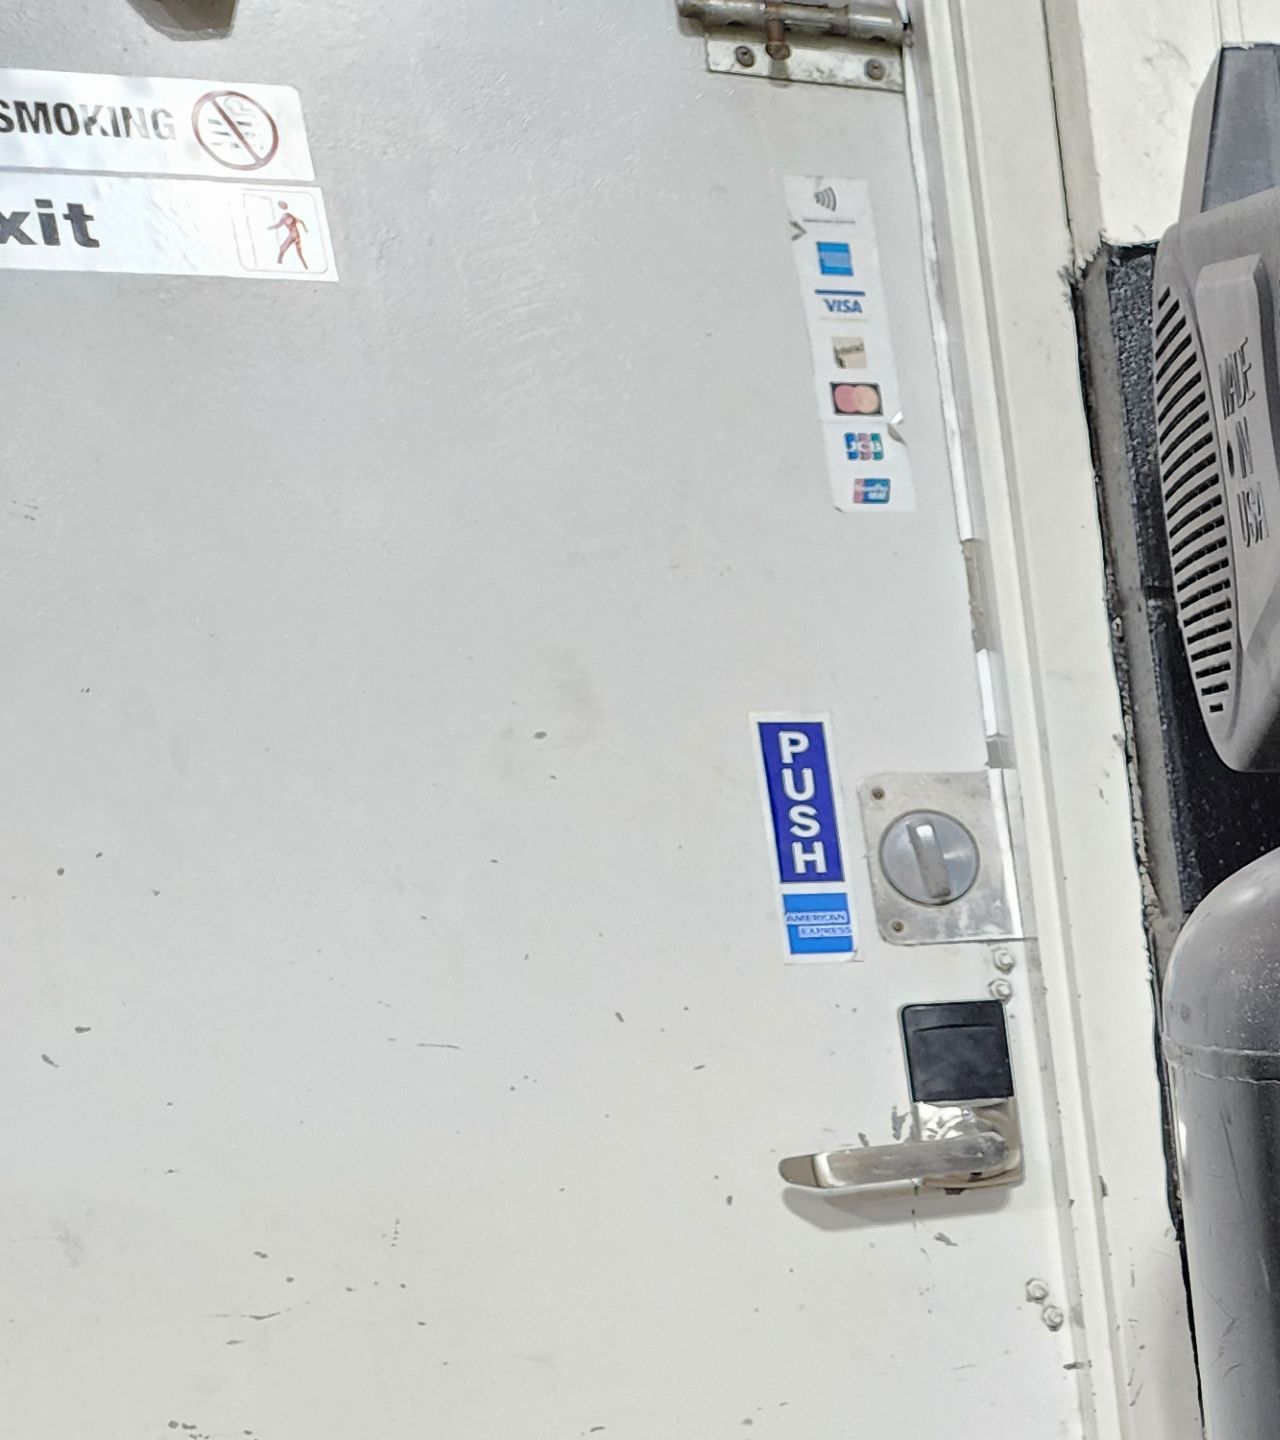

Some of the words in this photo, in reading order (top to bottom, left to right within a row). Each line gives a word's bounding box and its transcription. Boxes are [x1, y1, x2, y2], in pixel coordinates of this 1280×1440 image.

[0, 100, 176, 140] SMOKING
[823, 298, 863, 314] VISA
[778, 730, 828, 874] PUSH
